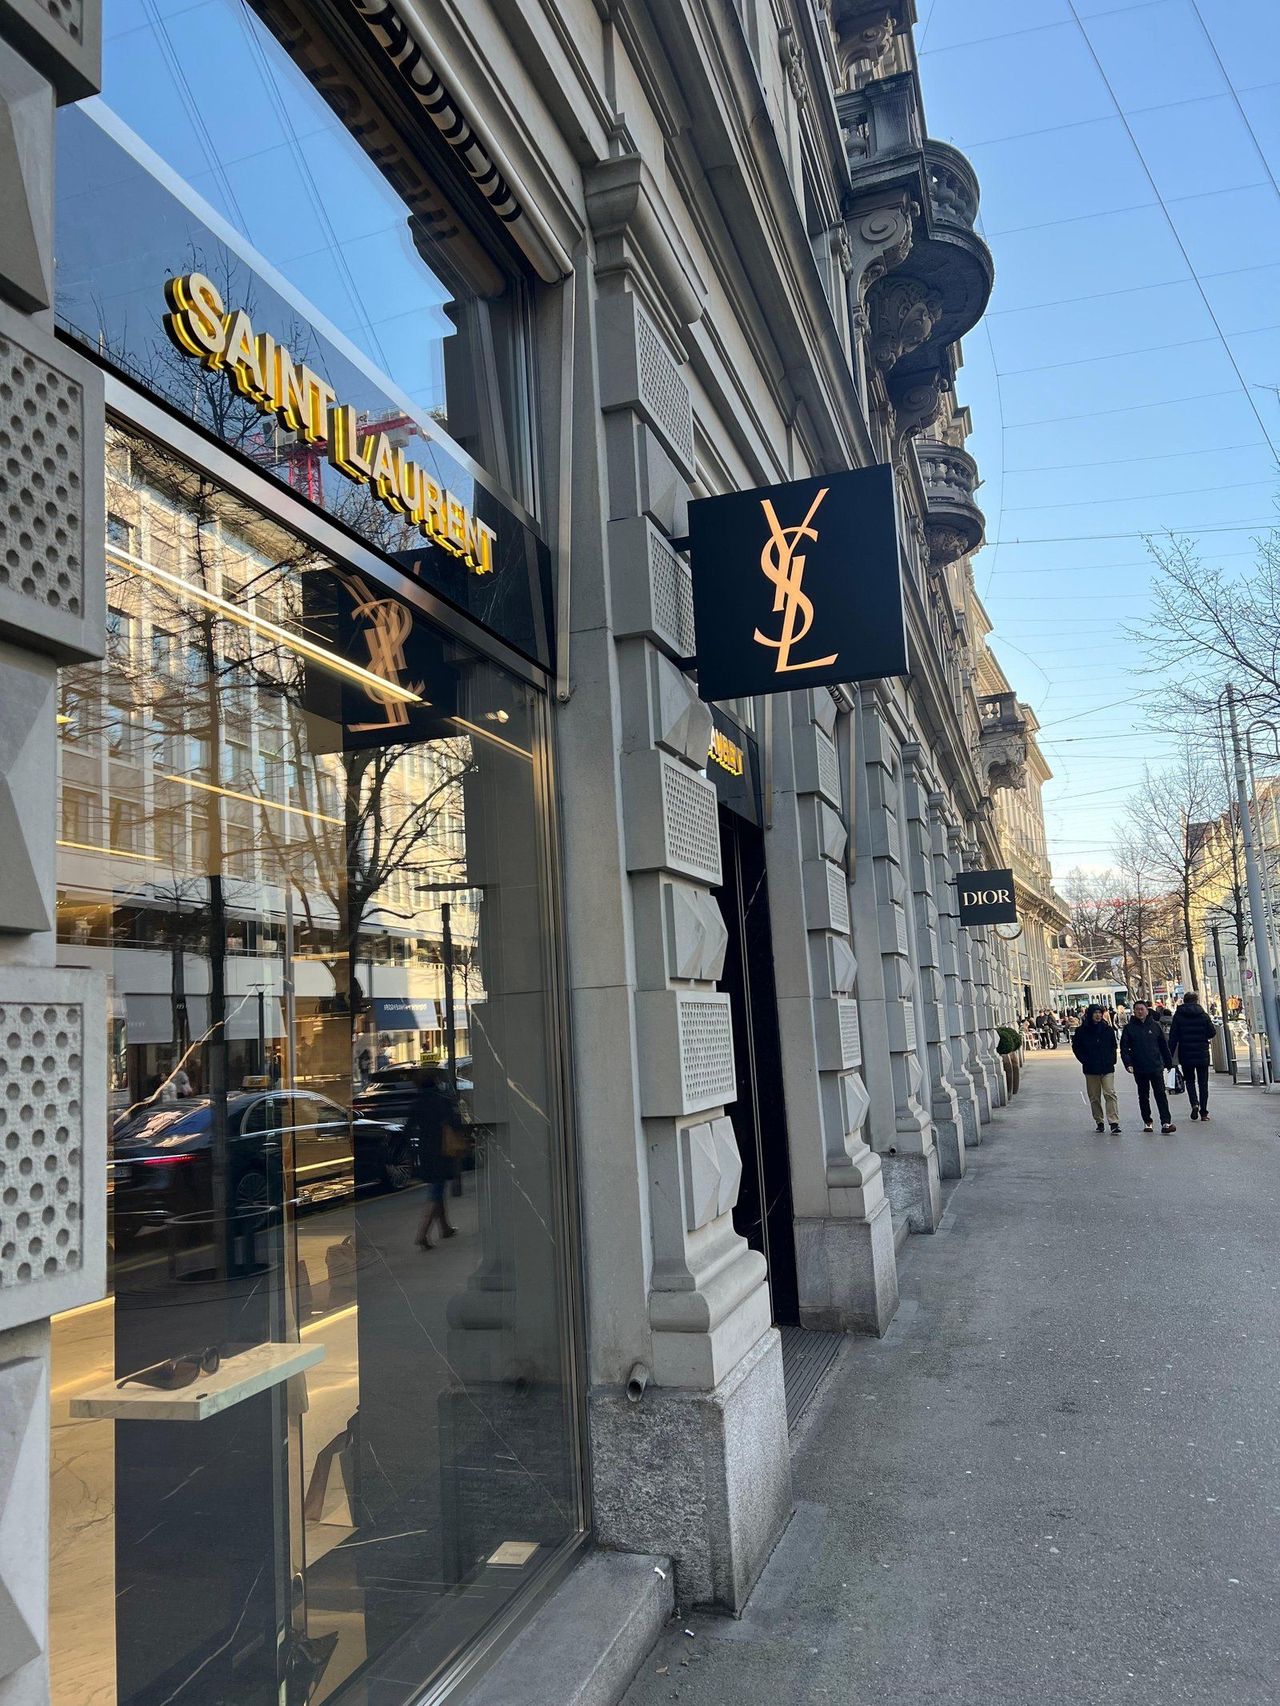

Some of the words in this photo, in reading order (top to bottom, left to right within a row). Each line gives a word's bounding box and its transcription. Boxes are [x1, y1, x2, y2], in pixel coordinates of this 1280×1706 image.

[163, 273, 336, 444] SAINT
[328, 404, 497, 576] LAURENT
[753, 487, 839, 673] YSL
[963, 889, 1012, 906] DIOR
